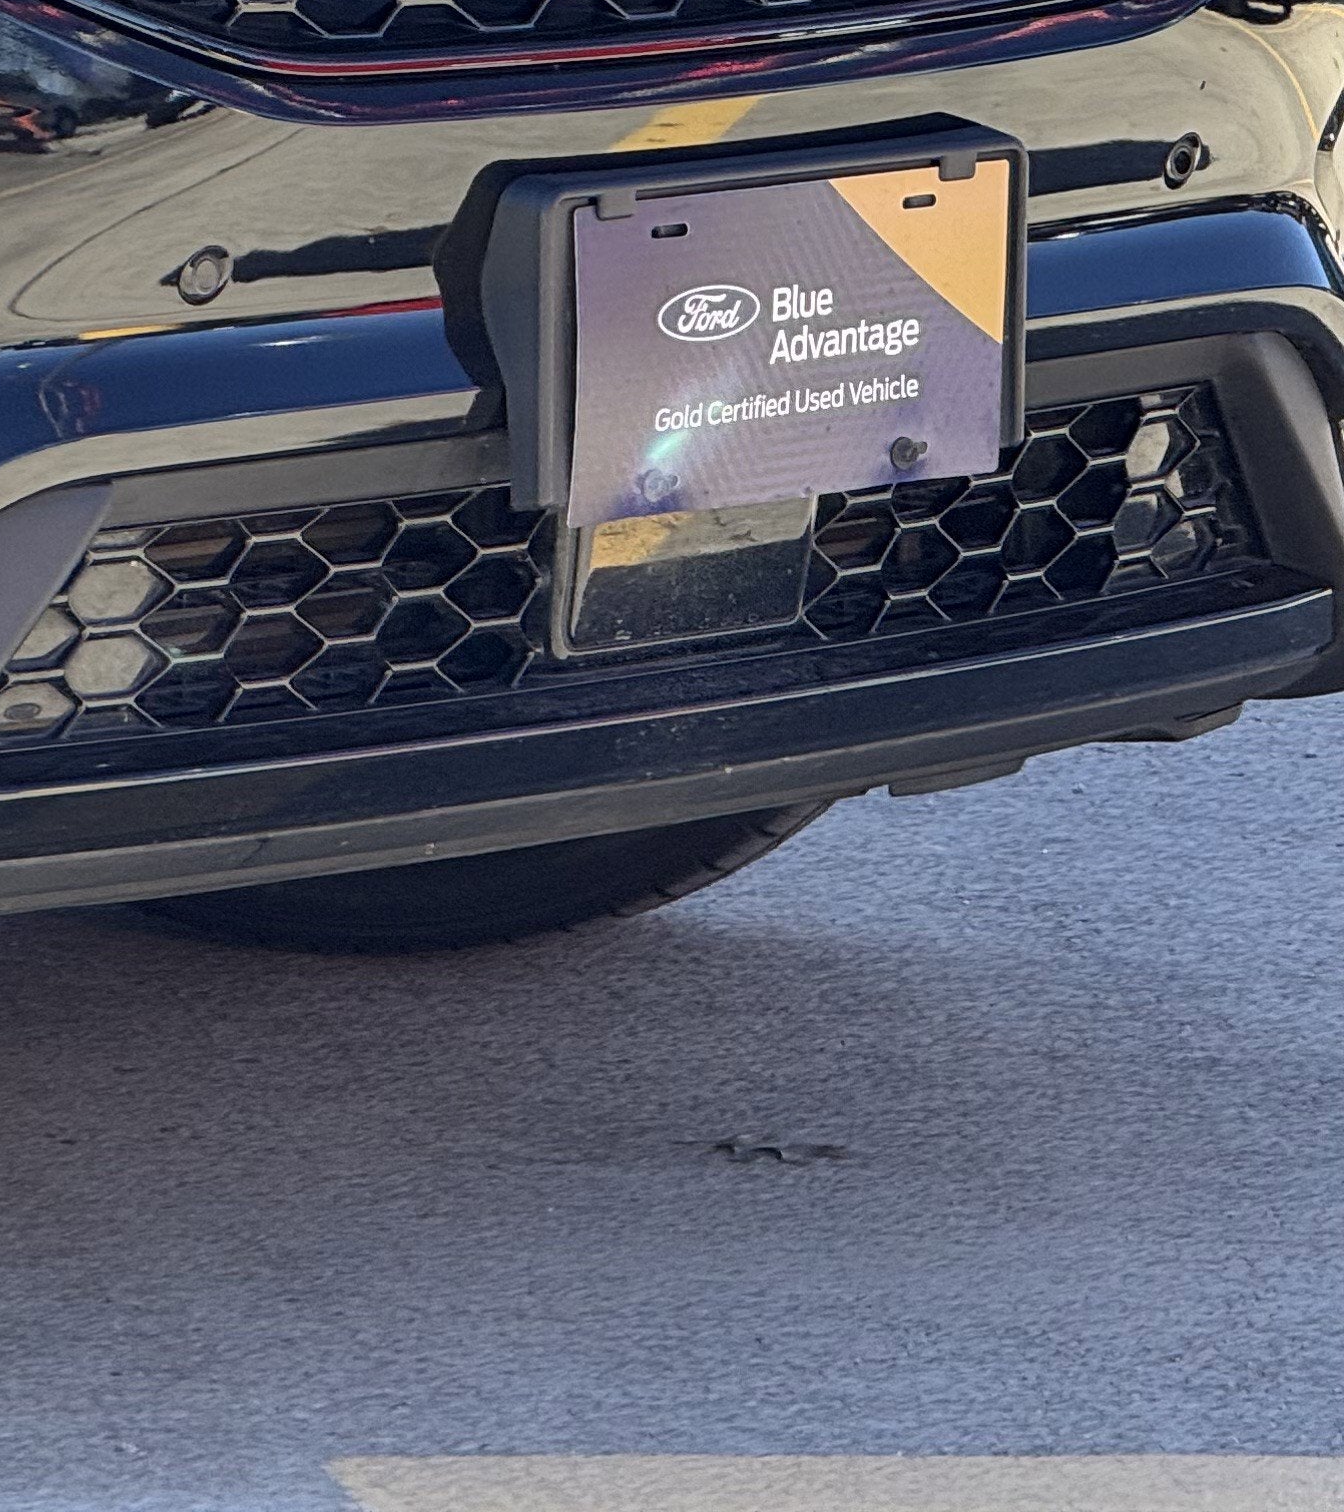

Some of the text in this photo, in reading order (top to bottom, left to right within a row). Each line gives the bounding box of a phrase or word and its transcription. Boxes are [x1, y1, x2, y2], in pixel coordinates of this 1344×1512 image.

[677, 293, 742, 333] Ford
[772, 284, 834, 322] Blue
[769, 317, 920, 365] Advantage
[654, 374, 919, 432] Gold Certified Used Vehicle
